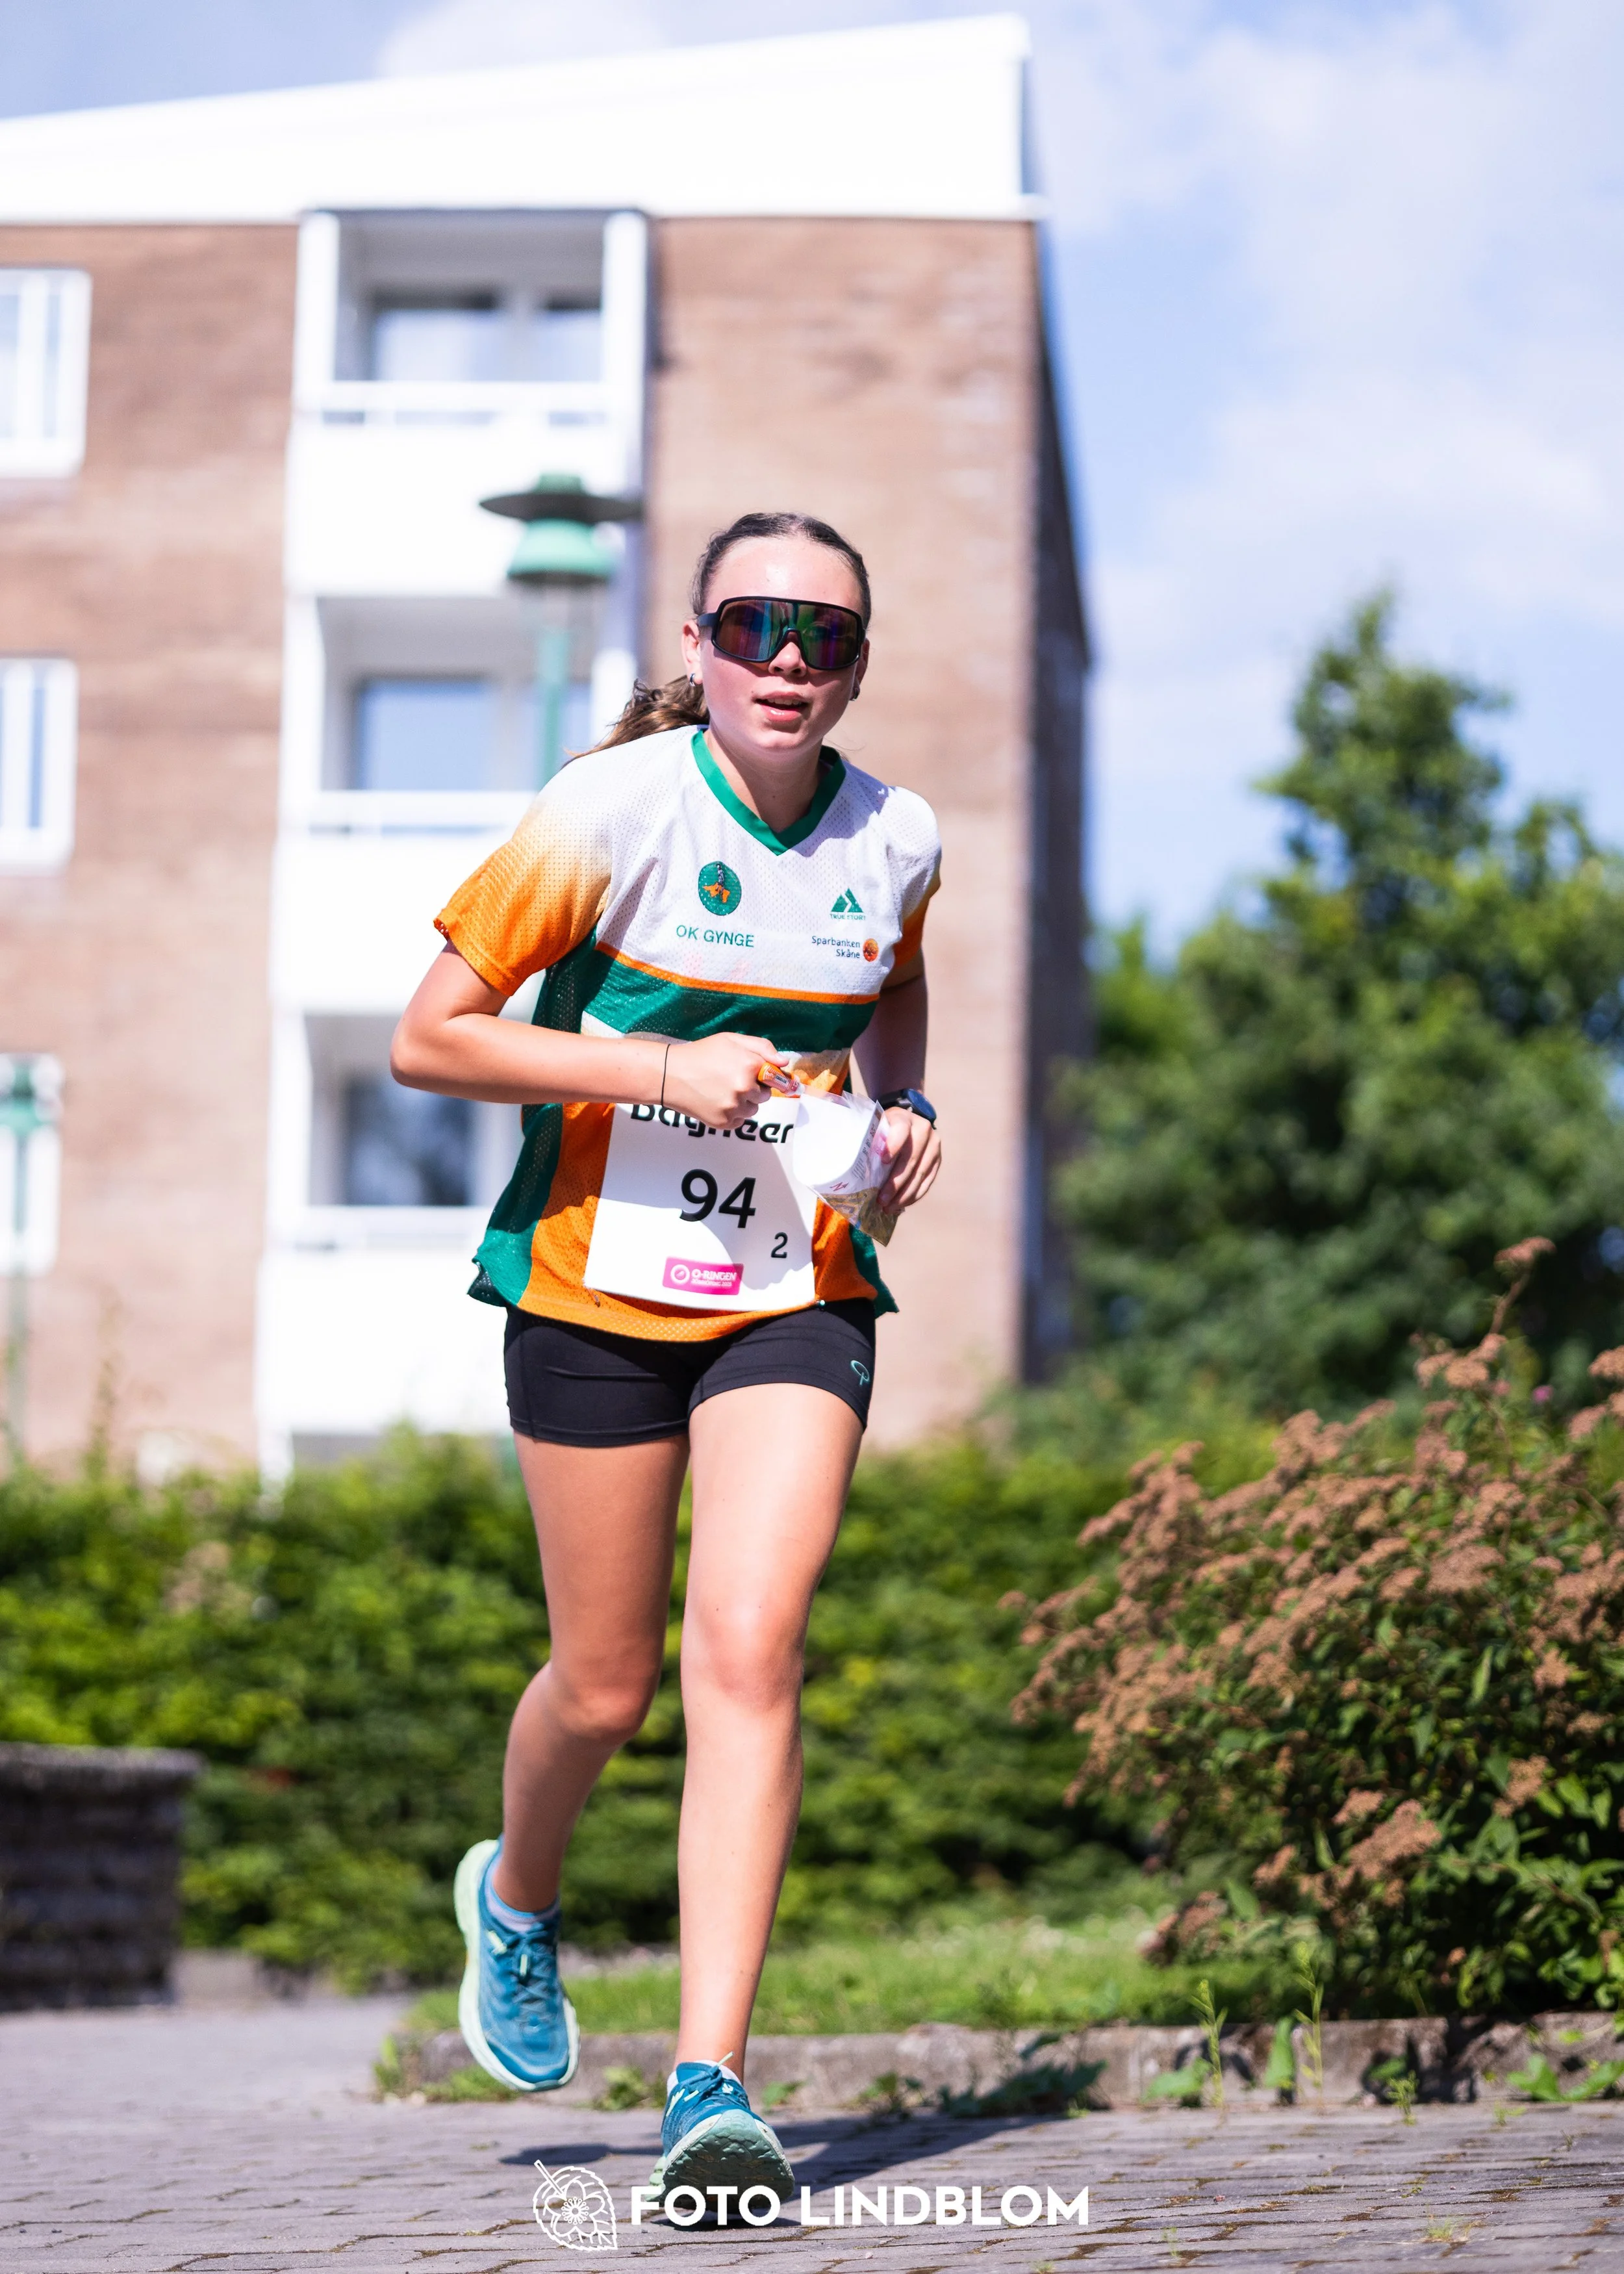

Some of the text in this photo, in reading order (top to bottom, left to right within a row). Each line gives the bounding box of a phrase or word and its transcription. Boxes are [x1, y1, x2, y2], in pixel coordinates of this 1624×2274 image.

[676, 924, 754, 947] OK GYNGE
[812, 936, 860, 948] Sparbanken
[836, 949, 860, 958] Skåne
[679, 1169, 756, 1229] 94
[771, 1232, 787, 1258] 2
[691, 1268, 737, 1281] O-RINGEN
